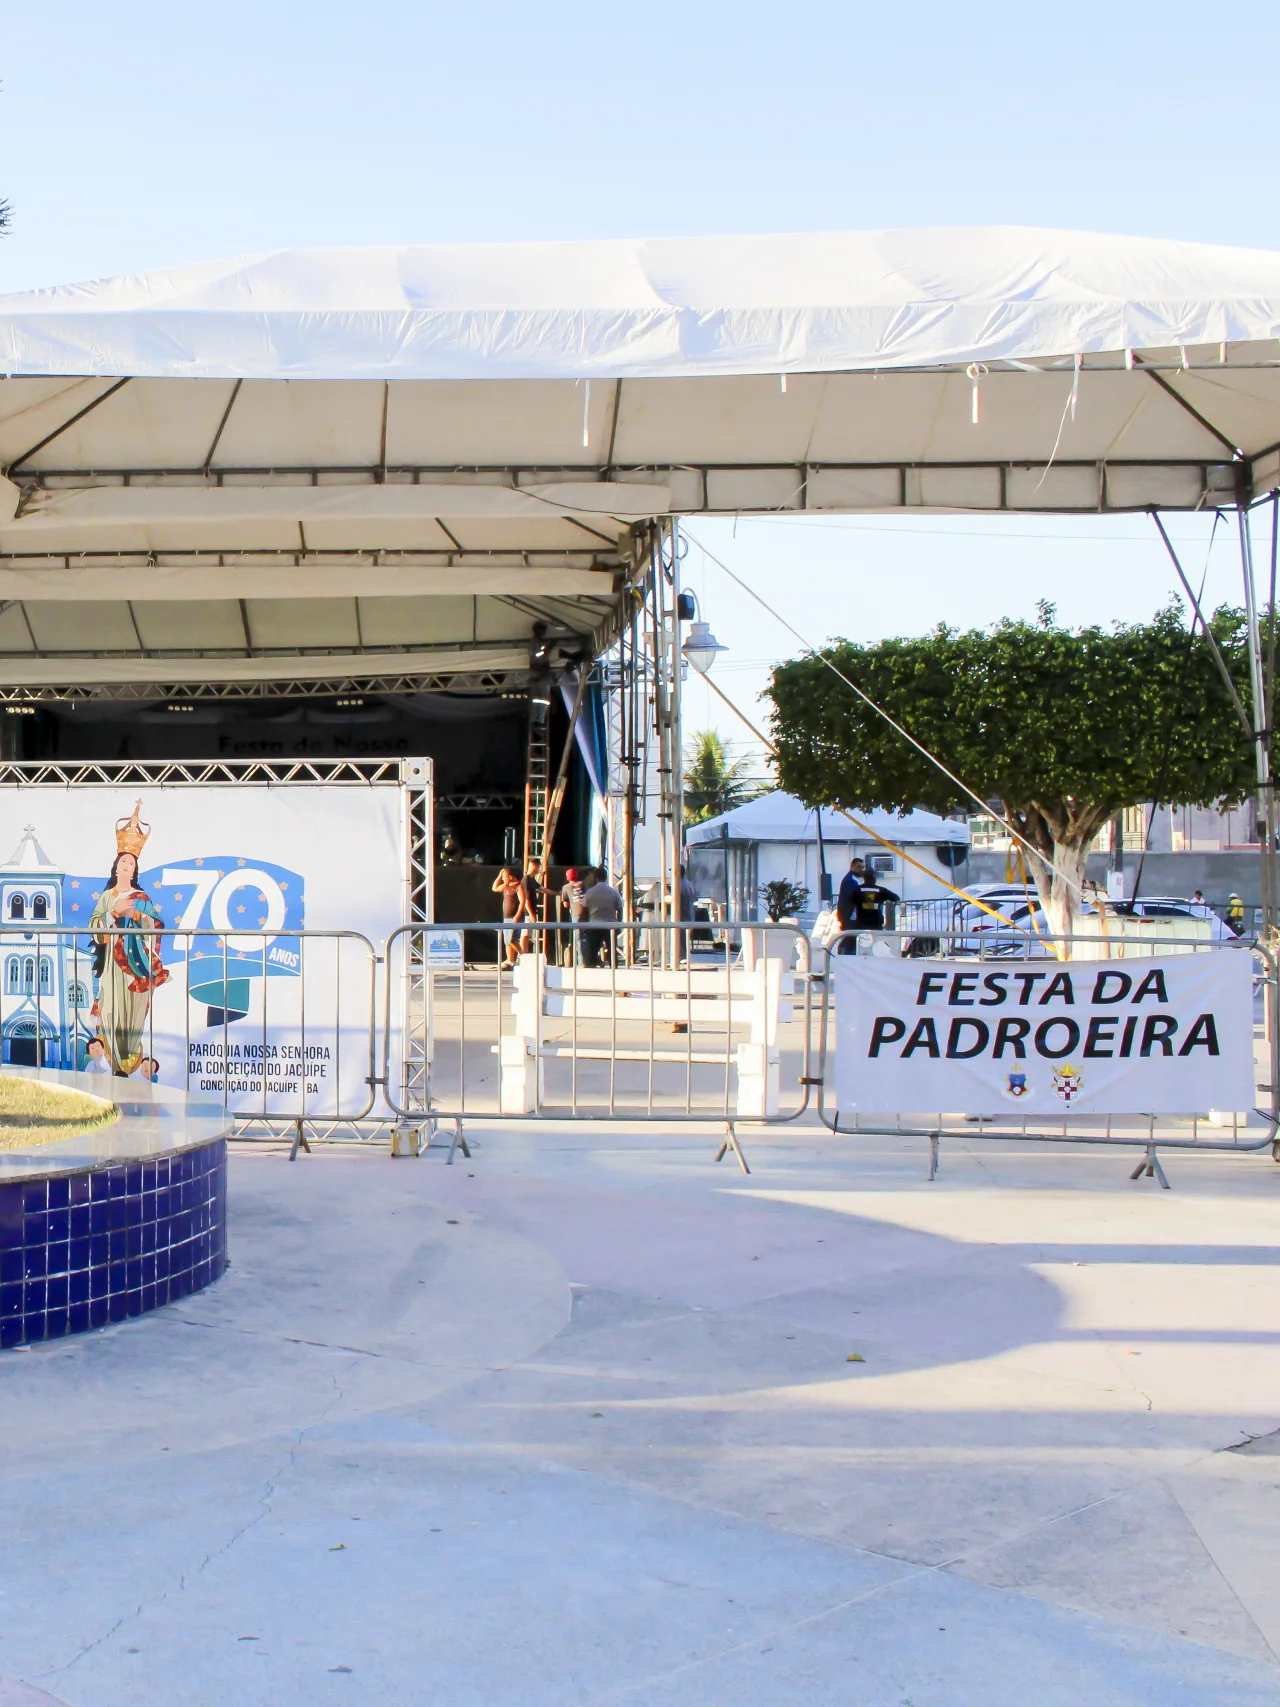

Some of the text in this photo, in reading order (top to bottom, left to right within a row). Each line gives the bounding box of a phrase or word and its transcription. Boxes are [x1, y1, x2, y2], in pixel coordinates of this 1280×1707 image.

[219, 732, 409, 753] Festa de Nossa
[162, 868, 286, 953] 70
[268, 947, 299, 968] ANOS
[915, 968, 1169, 1006] FESTA DA
[867, 1013, 1221, 1059] PADROEIRA
[243, 1044, 278, 1059] NOSSA
[281, 1045, 331, 1060] SENHORA
[189, 1060, 327, 1078] DA CONCEIÇÃO DO JACUÍPE
[250, 1081, 262, 1092] DO
[307, 1083, 319, 1094] BA
